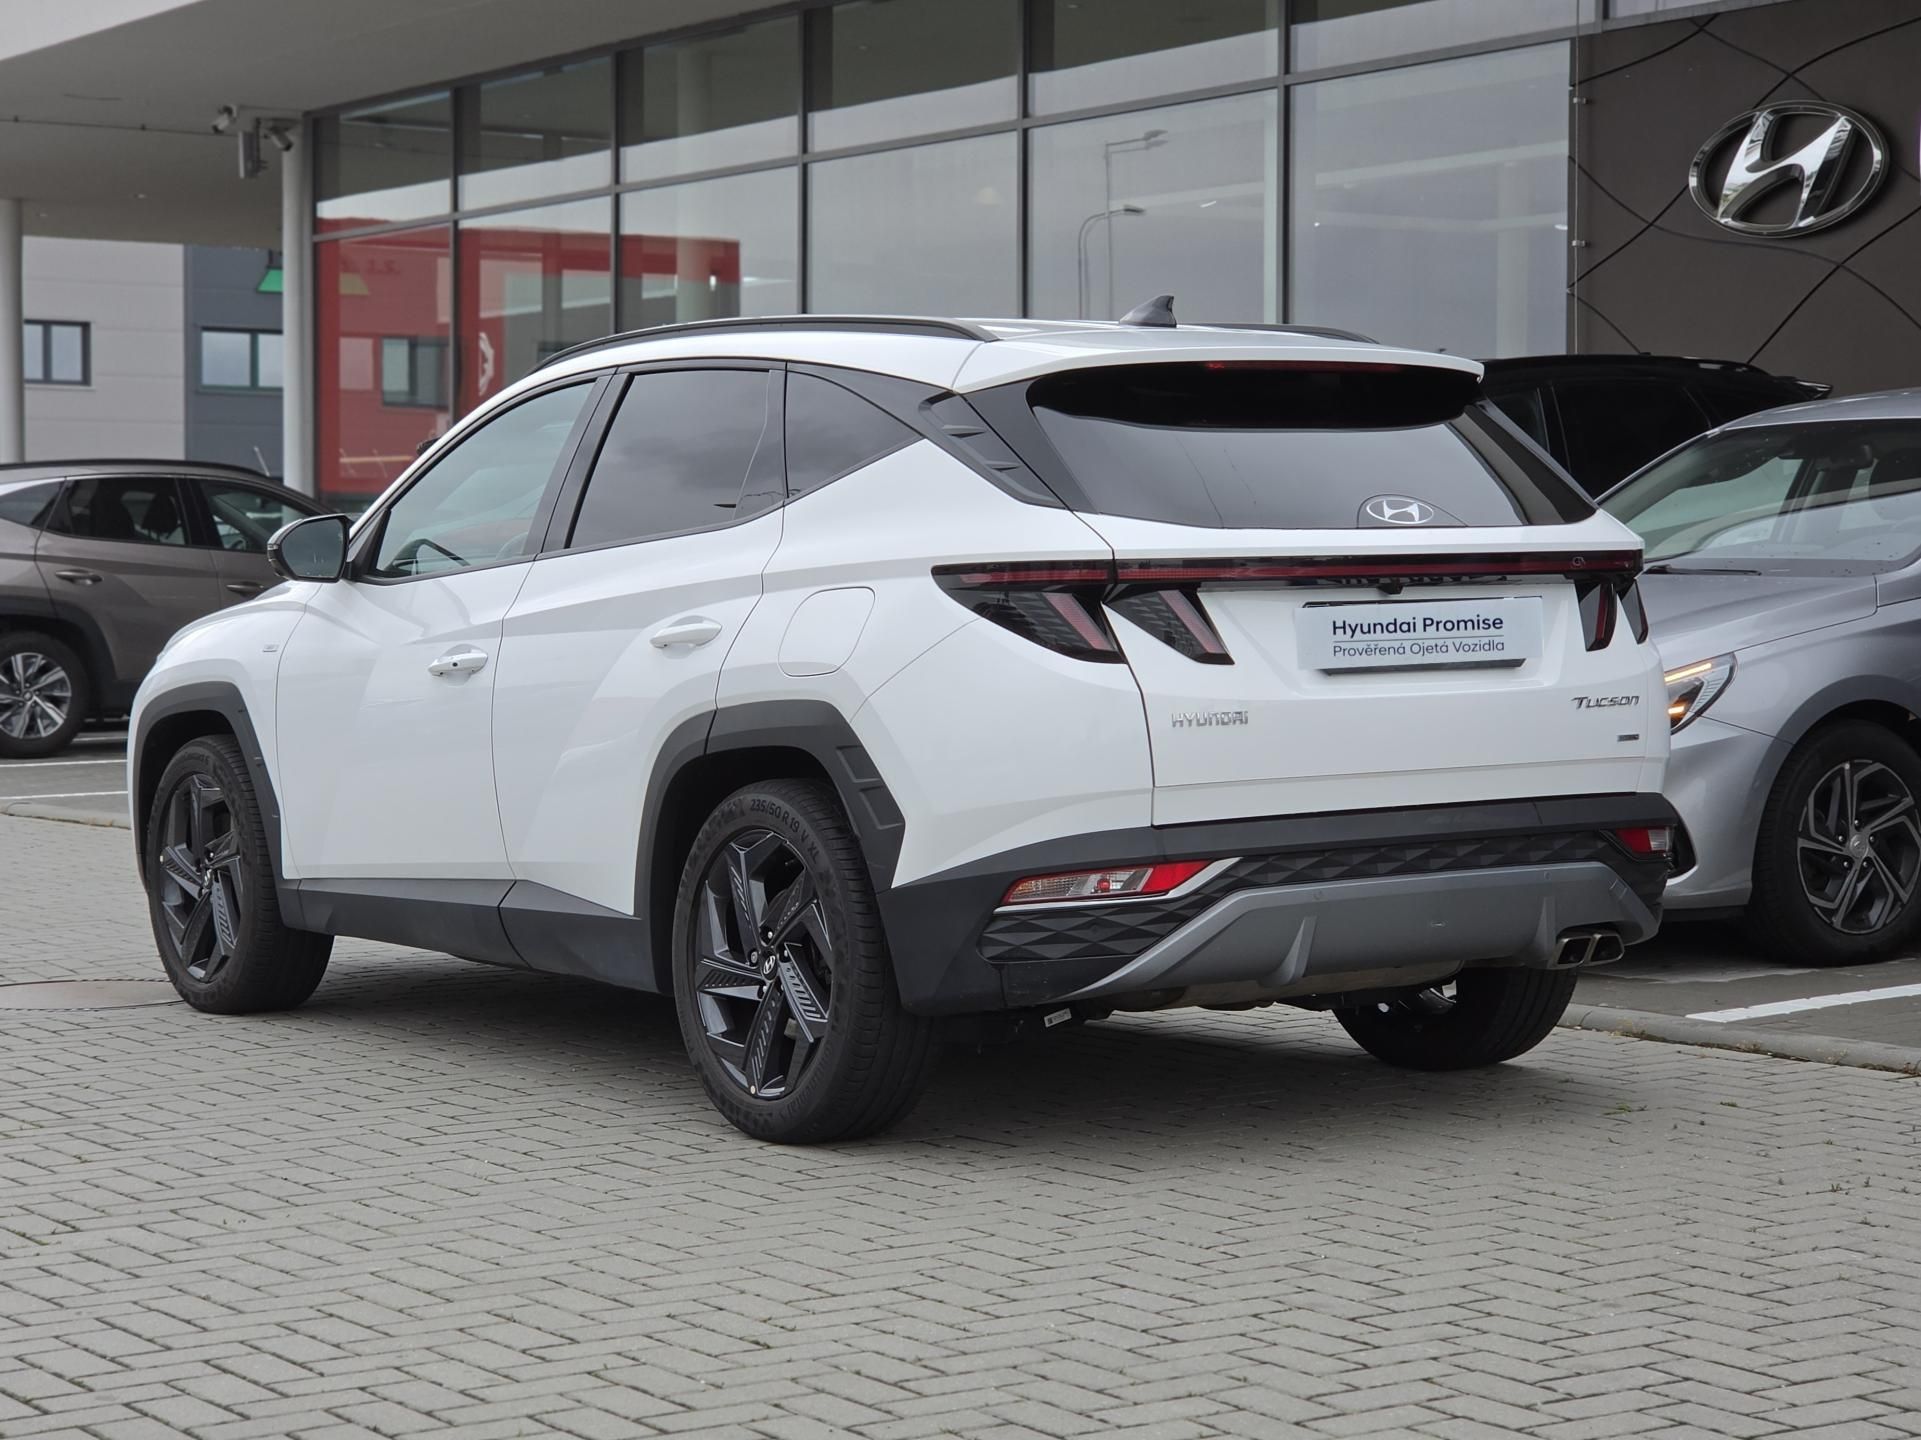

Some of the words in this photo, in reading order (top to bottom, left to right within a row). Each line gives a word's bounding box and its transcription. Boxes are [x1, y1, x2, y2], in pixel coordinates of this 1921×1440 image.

[1332, 616, 1417, 639] Hyundai
[1422, 613, 1504, 633] Promise
[1332, 642, 1406, 657] Prověřená
[1409, 640, 1449, 657] Ojetá
[1452, 639, 1505, 653] Vozidla
[750, 798, 782, 820] 235/50
[781, 809, 790, 827] R
[789, 816, 801, 833] 19
